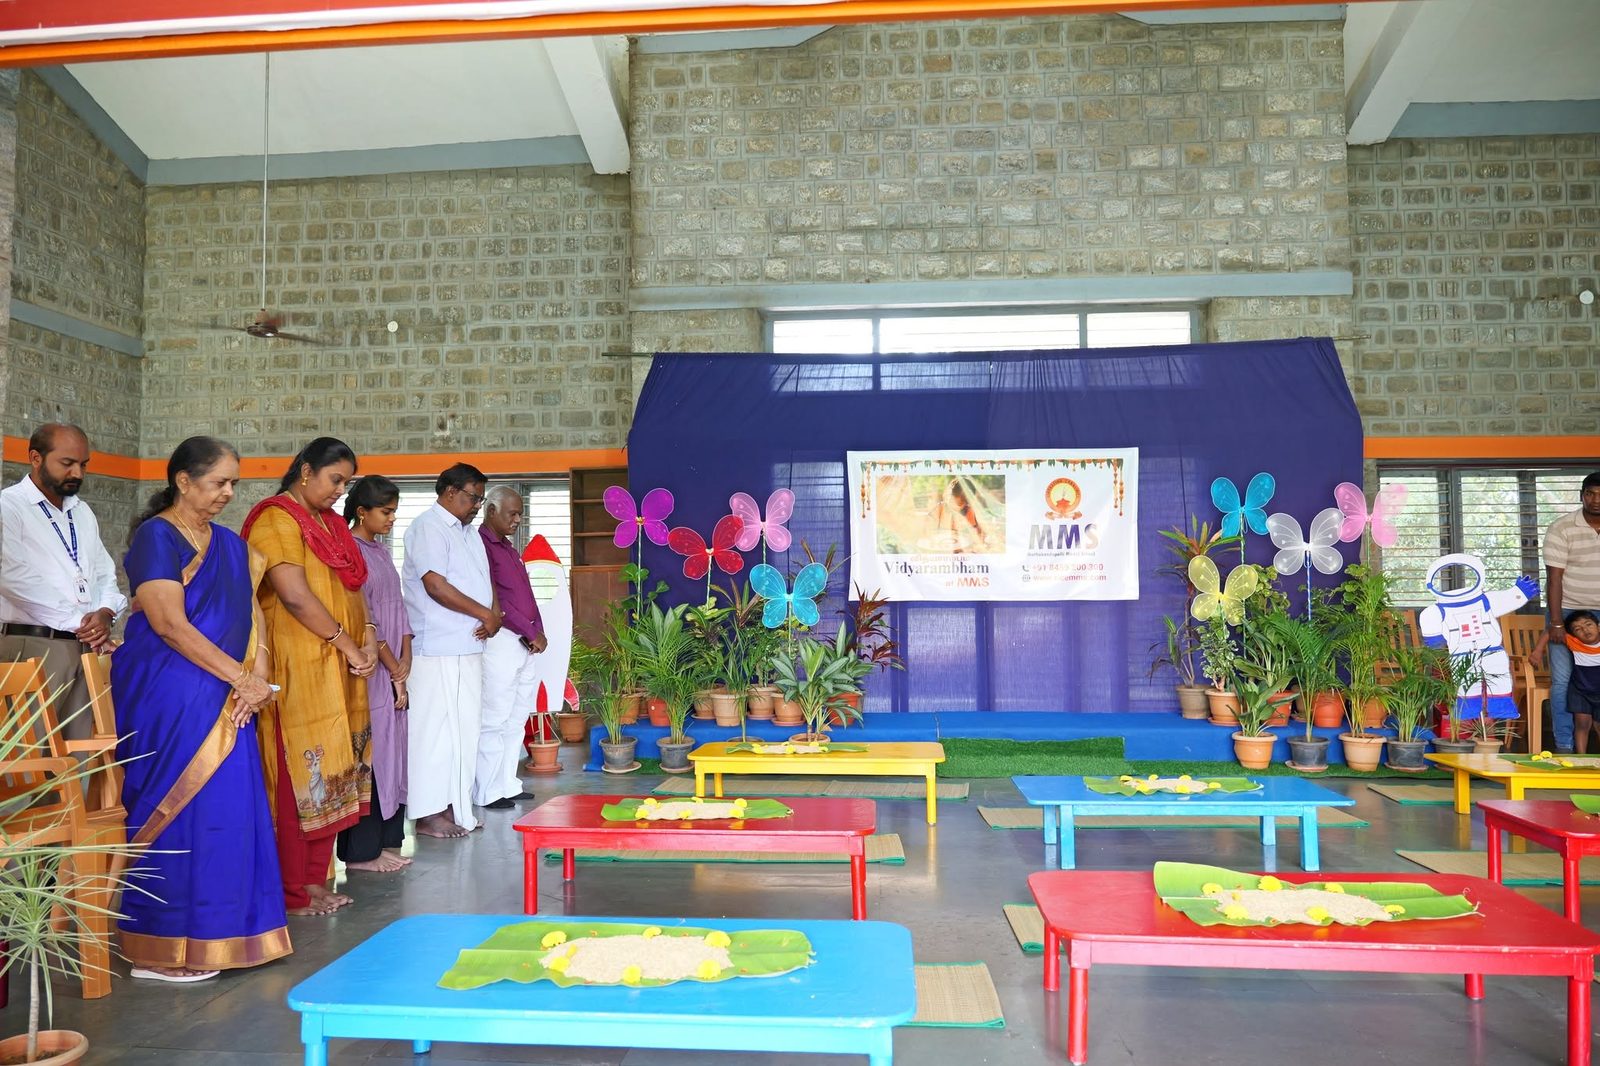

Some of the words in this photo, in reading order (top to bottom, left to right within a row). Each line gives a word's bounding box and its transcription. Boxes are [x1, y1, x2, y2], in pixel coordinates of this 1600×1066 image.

[1029, 523, 1098, 549] MMS
[884, 561, 989, 577] Vidyarambham
[957, 577, 990, 587] MMS
